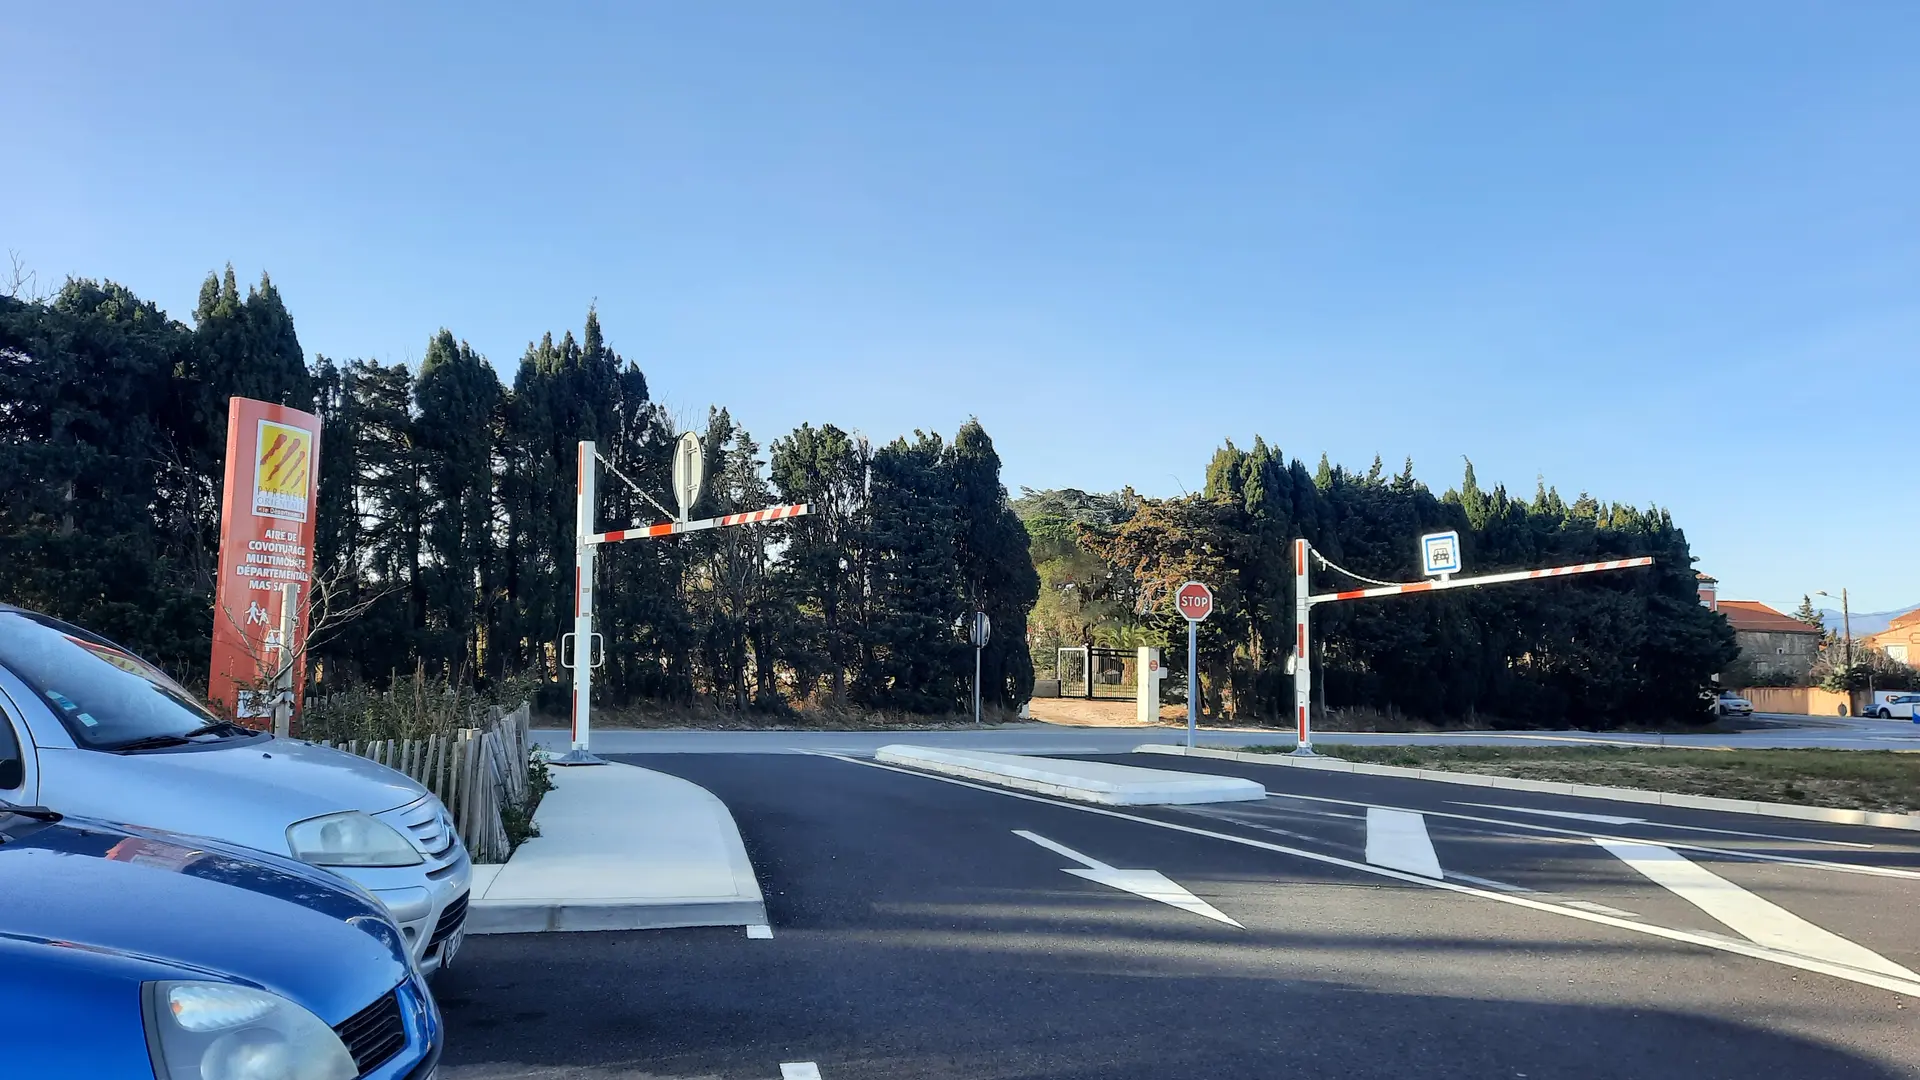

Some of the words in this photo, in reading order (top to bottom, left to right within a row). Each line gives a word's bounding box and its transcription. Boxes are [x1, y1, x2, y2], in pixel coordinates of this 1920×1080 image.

[265, 529, 286, 540] AIRE
[287, 532, 297, 542] DE
[248, 541, 305, 556] COVOITURAGE
[246, 554, 305, 568] MULTIMODLE
[236, 565, 308, 581] DÉPARTEMENTALE
[249, 580, 271, 591] MAS
[273, 582, 301, 594] SAE
[1181, 596, 1208, 607] STOP
